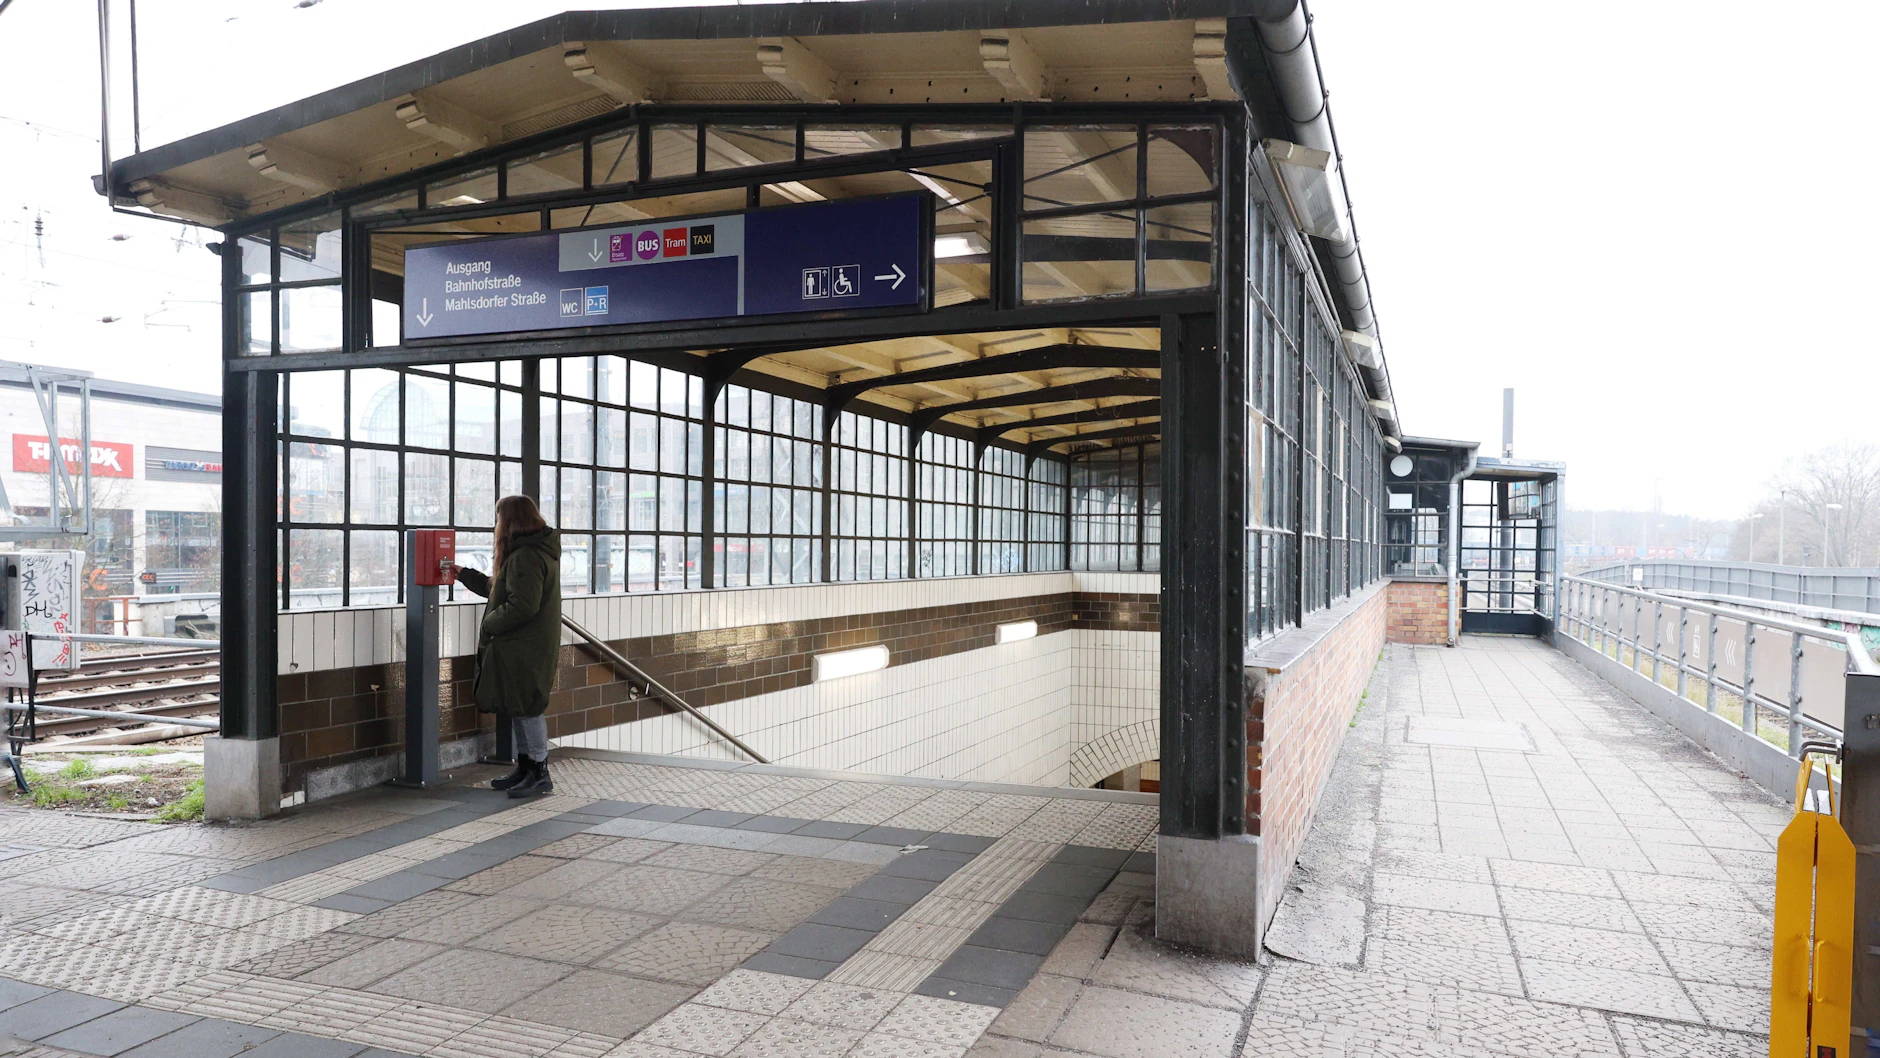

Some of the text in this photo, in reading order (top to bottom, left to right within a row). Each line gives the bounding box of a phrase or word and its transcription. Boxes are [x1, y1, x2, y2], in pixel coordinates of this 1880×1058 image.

[637, 239, 659, 252] BUS
[665, 238, 686, 249] Tram
[692, 234, 712, 246] TAXI
[446, 260, 491, 276] Ausgang
[445, 275, 522, 293] Bahnhofstraße
[445, 291, 547, 312] Mahlsdorfer Straße
[562, 302, 578, 314] WC
